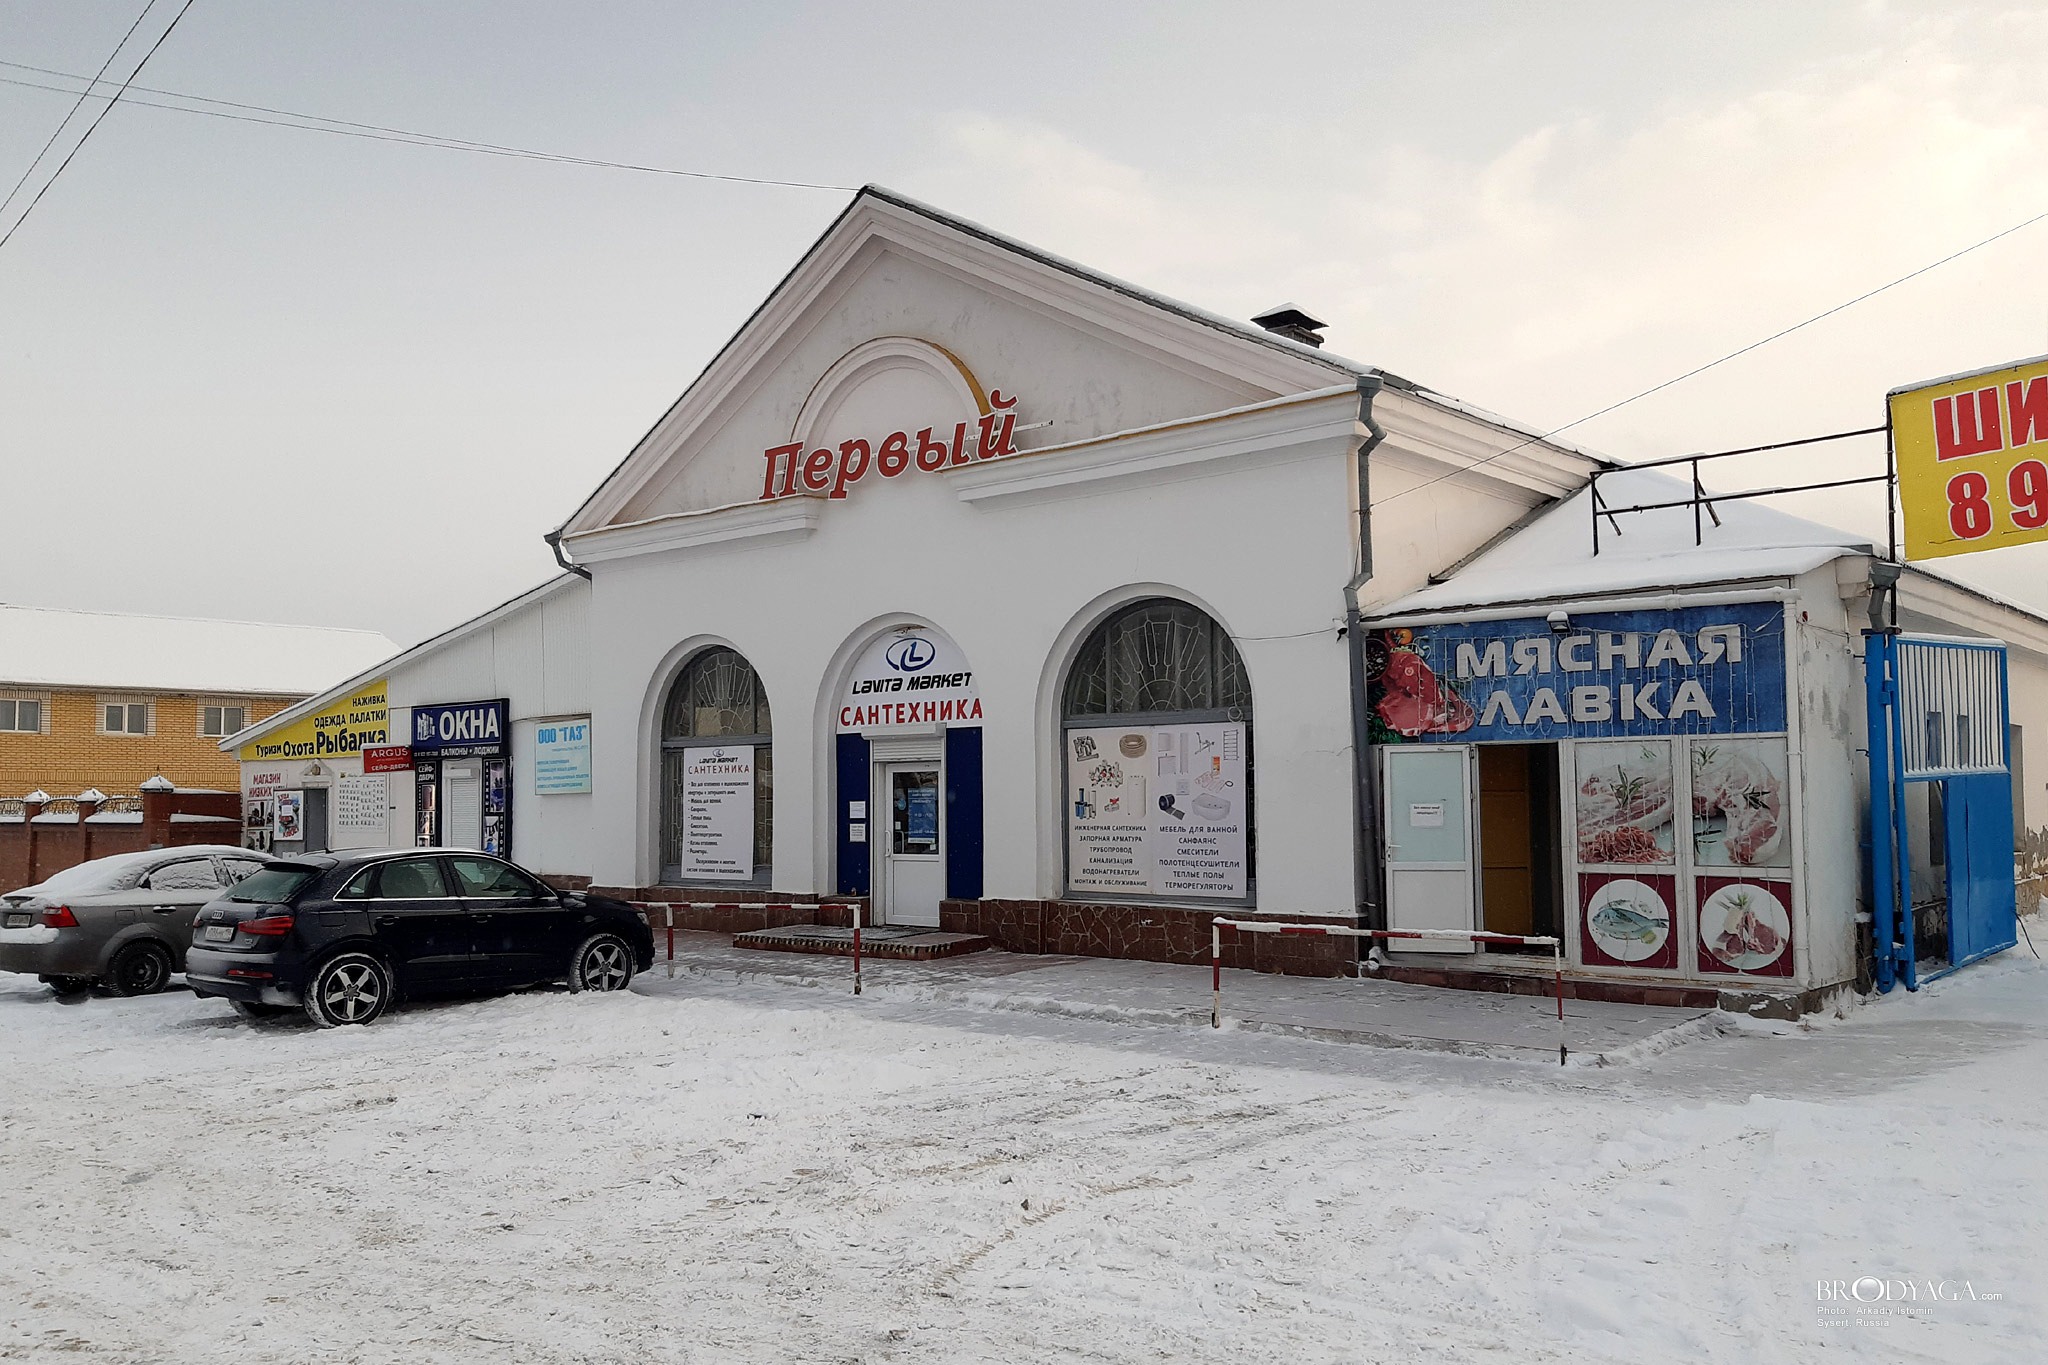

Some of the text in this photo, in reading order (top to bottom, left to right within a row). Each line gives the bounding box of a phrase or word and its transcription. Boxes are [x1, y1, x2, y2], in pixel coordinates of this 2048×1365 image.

[759, 388, 1019, 500] Первый
[1455, 622, 1743, 679] МЯСНАЯ
[352, 694, 386, 708] НАЖИВКА
[1478, 680, 1717, 726] ЛАВКА
[840, 697, 983, 727] САНТЕХНИКА
[314, 709, 387, 729] ОДЕЖДА ПАЛАТКИ
[439, 707, 500, 740] ОКНА
[255, 728, 387, 758] Туризм Охота Рыбалка
[371, 747, 409, 758] ARGUS
[440, 747, 469, 757] БАЛКОНЫ
[473, 745, 500, 757] ЛОДЖИИ
[688, 764, 750, 775] САНТЕХНИКА
[253, 772, 281, 785] МАГАЗИН
[1189, 826, 1204, 834] ДЛЯ
[1207, 825, 1238, 833] ВАННОЙ
[1089, 846, 1132, 854] ТРУБОПРОВОД
[1176, 848, 1219, 856] СМЕСИТЕЛИ
[1089, 857, 1133, 865] КАНАЛИЗАЦИЯ
[1158, 859, 1240, 868] ПОЛОТЕНЦЕСУШИТЕЛИ
[1082, 868, 1140, 876] ВОДОНАГРЕВАТЕЛИ
[1173, 870, 1224, 879] ТЕПЛЫЕ ПОЛЫ
[1165, 881, 1234, 891] ТЕРМОРЕГУЛЯТОРЫ
